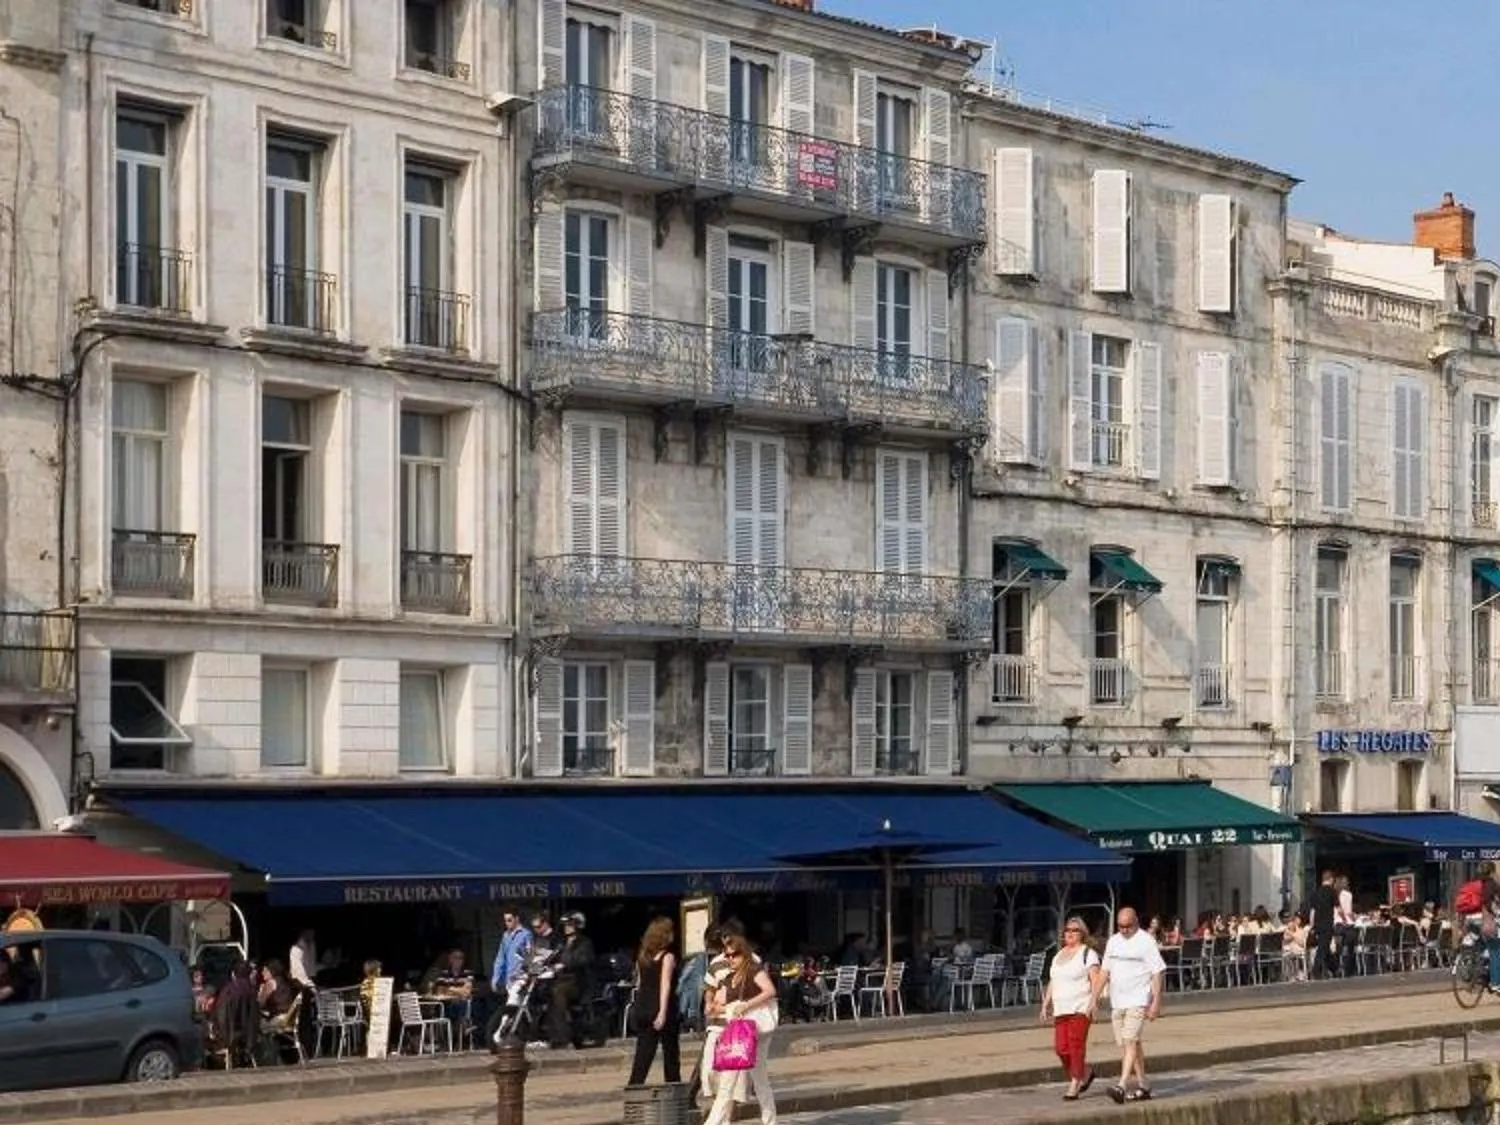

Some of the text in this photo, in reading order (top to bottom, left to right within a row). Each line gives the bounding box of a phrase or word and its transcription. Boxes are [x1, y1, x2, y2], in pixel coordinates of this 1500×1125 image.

[1318, 730, 1352, 752] LES
[1212, 828, 1237, 843] 22
[79, 884, 133, 901] WORLD
[343, 884, 465, 903] RESTAURANT
[488, 881, 549, 900] FRUITS
